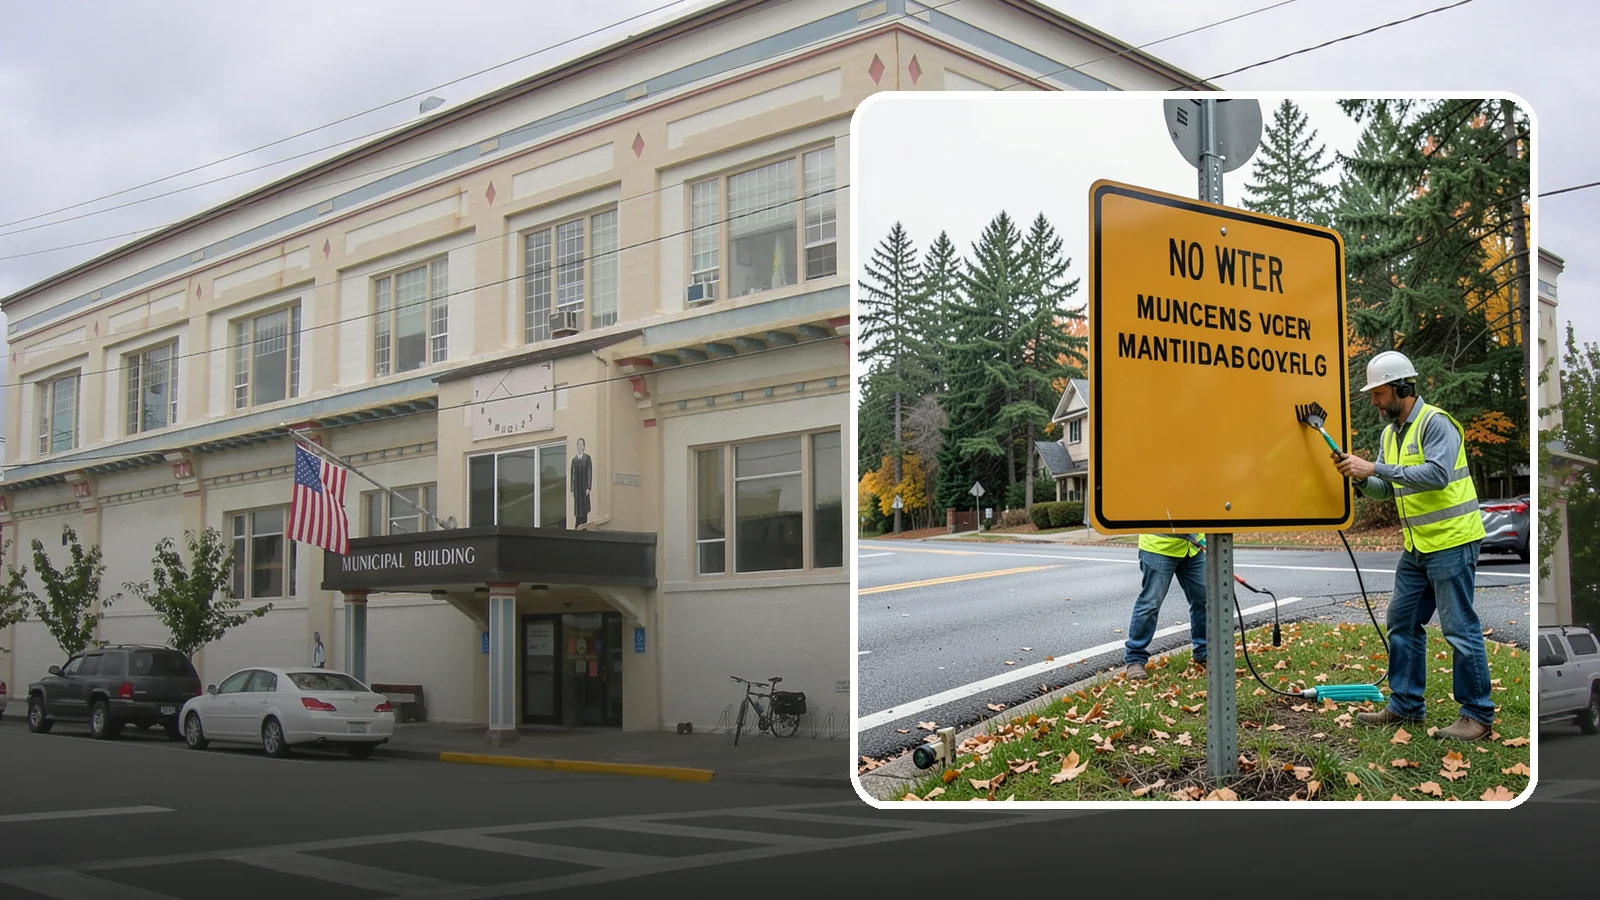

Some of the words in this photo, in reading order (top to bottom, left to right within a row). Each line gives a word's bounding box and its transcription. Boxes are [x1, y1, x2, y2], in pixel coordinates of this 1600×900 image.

[1169, 238, 1205, 281] NO
[1215, 244, 1284, 294] WTER
[1136, 294, 1252, 333] MUNCENS
[488, 418, 492, 426] 9
[536, 402, 540, 410] 4
[342, 552, 405, 572] MUNICIPAL
[414, 546, 475, 567] BUILDING
